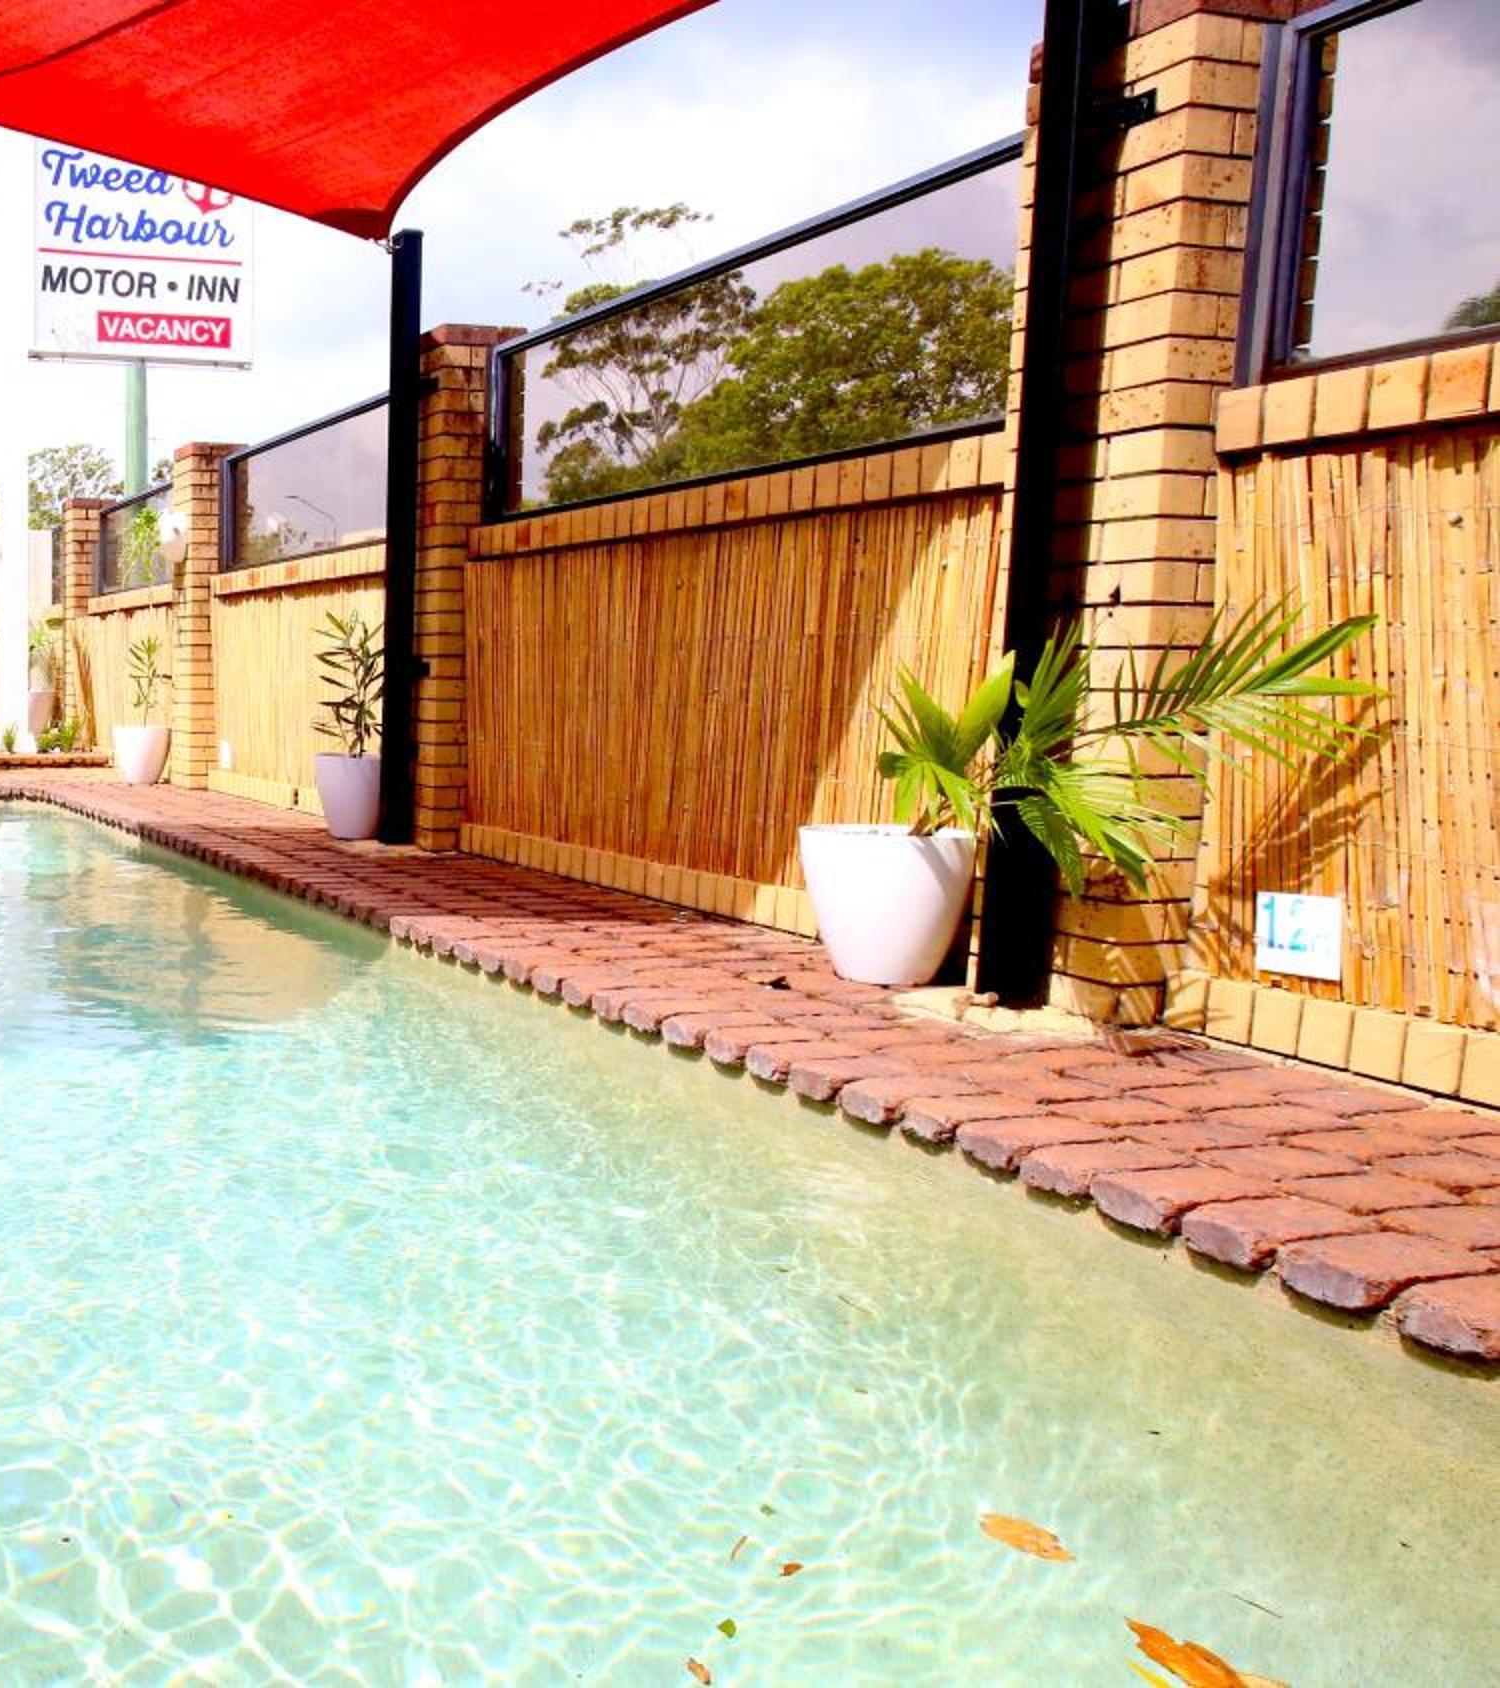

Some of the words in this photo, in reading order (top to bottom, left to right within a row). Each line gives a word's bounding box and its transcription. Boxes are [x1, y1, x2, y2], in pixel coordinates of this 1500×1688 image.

[44, 200, 235, 248] Harbour
[41, 265, 157, 299] MOTOR
[187, 274, 241, 303] INN
[102, 316, 226, 343] VACANCY
